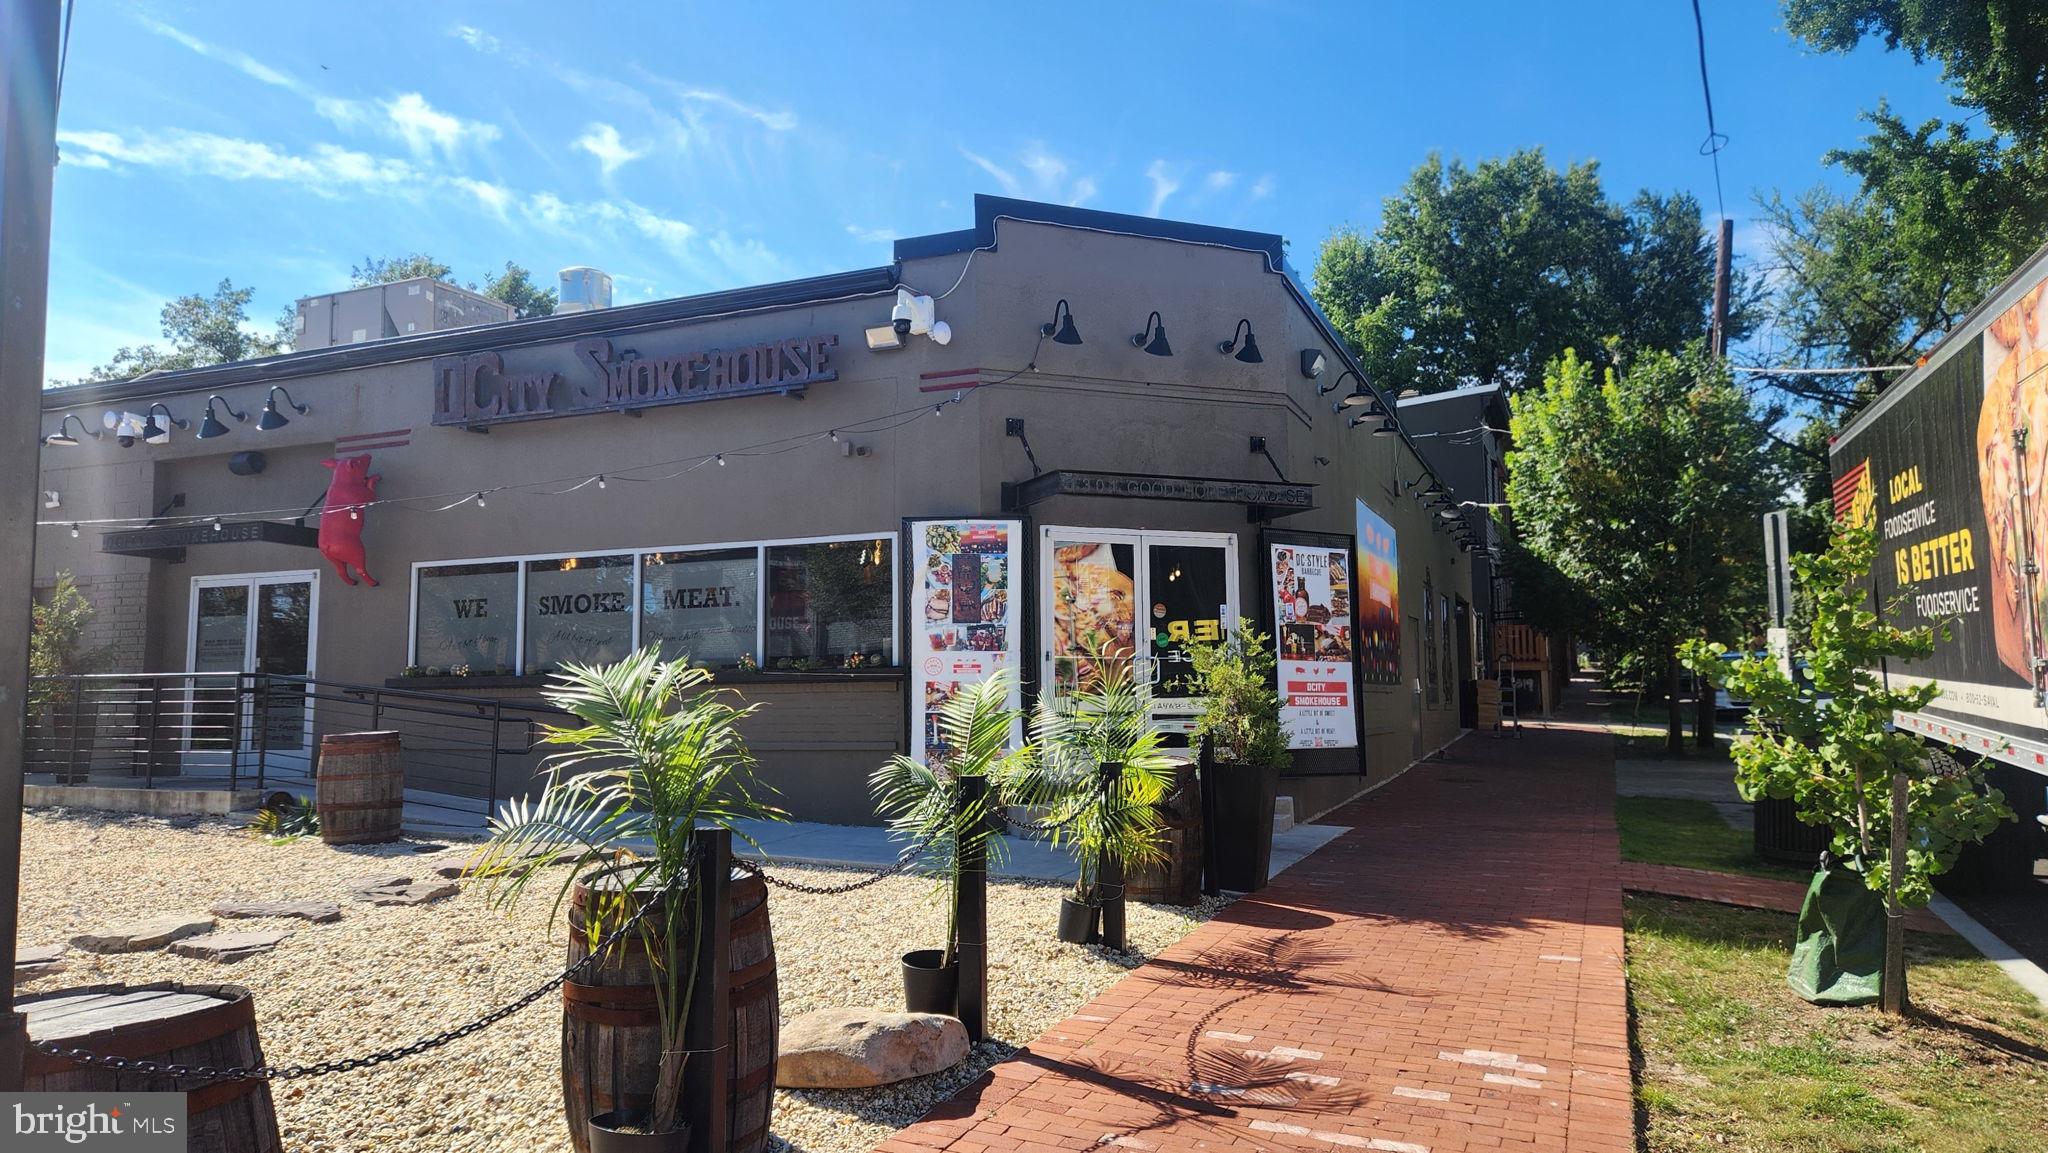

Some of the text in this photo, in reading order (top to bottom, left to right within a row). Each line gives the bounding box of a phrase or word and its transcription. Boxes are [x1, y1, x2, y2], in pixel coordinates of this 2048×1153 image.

[1127, 481, 1175, 498] GOOD
[1286, 489, 1305, 503] SE
[1889, 465, 1923, 504] LOCAL
[1884, 500, 1936, 540] FOODSERVICE
[1296, 554, 1327, 568] DC STYLE
[1895, 528, 1975, 585] IS BETTER
[453, 587, 740, 618] WE SMOKE MEAT.
[1916, 587, 1980, 617] FOODSERVICE
[1295, 696, 1342, 706] SMOKEHOUSE
[1306, 682, 1326, 692] DCITY
